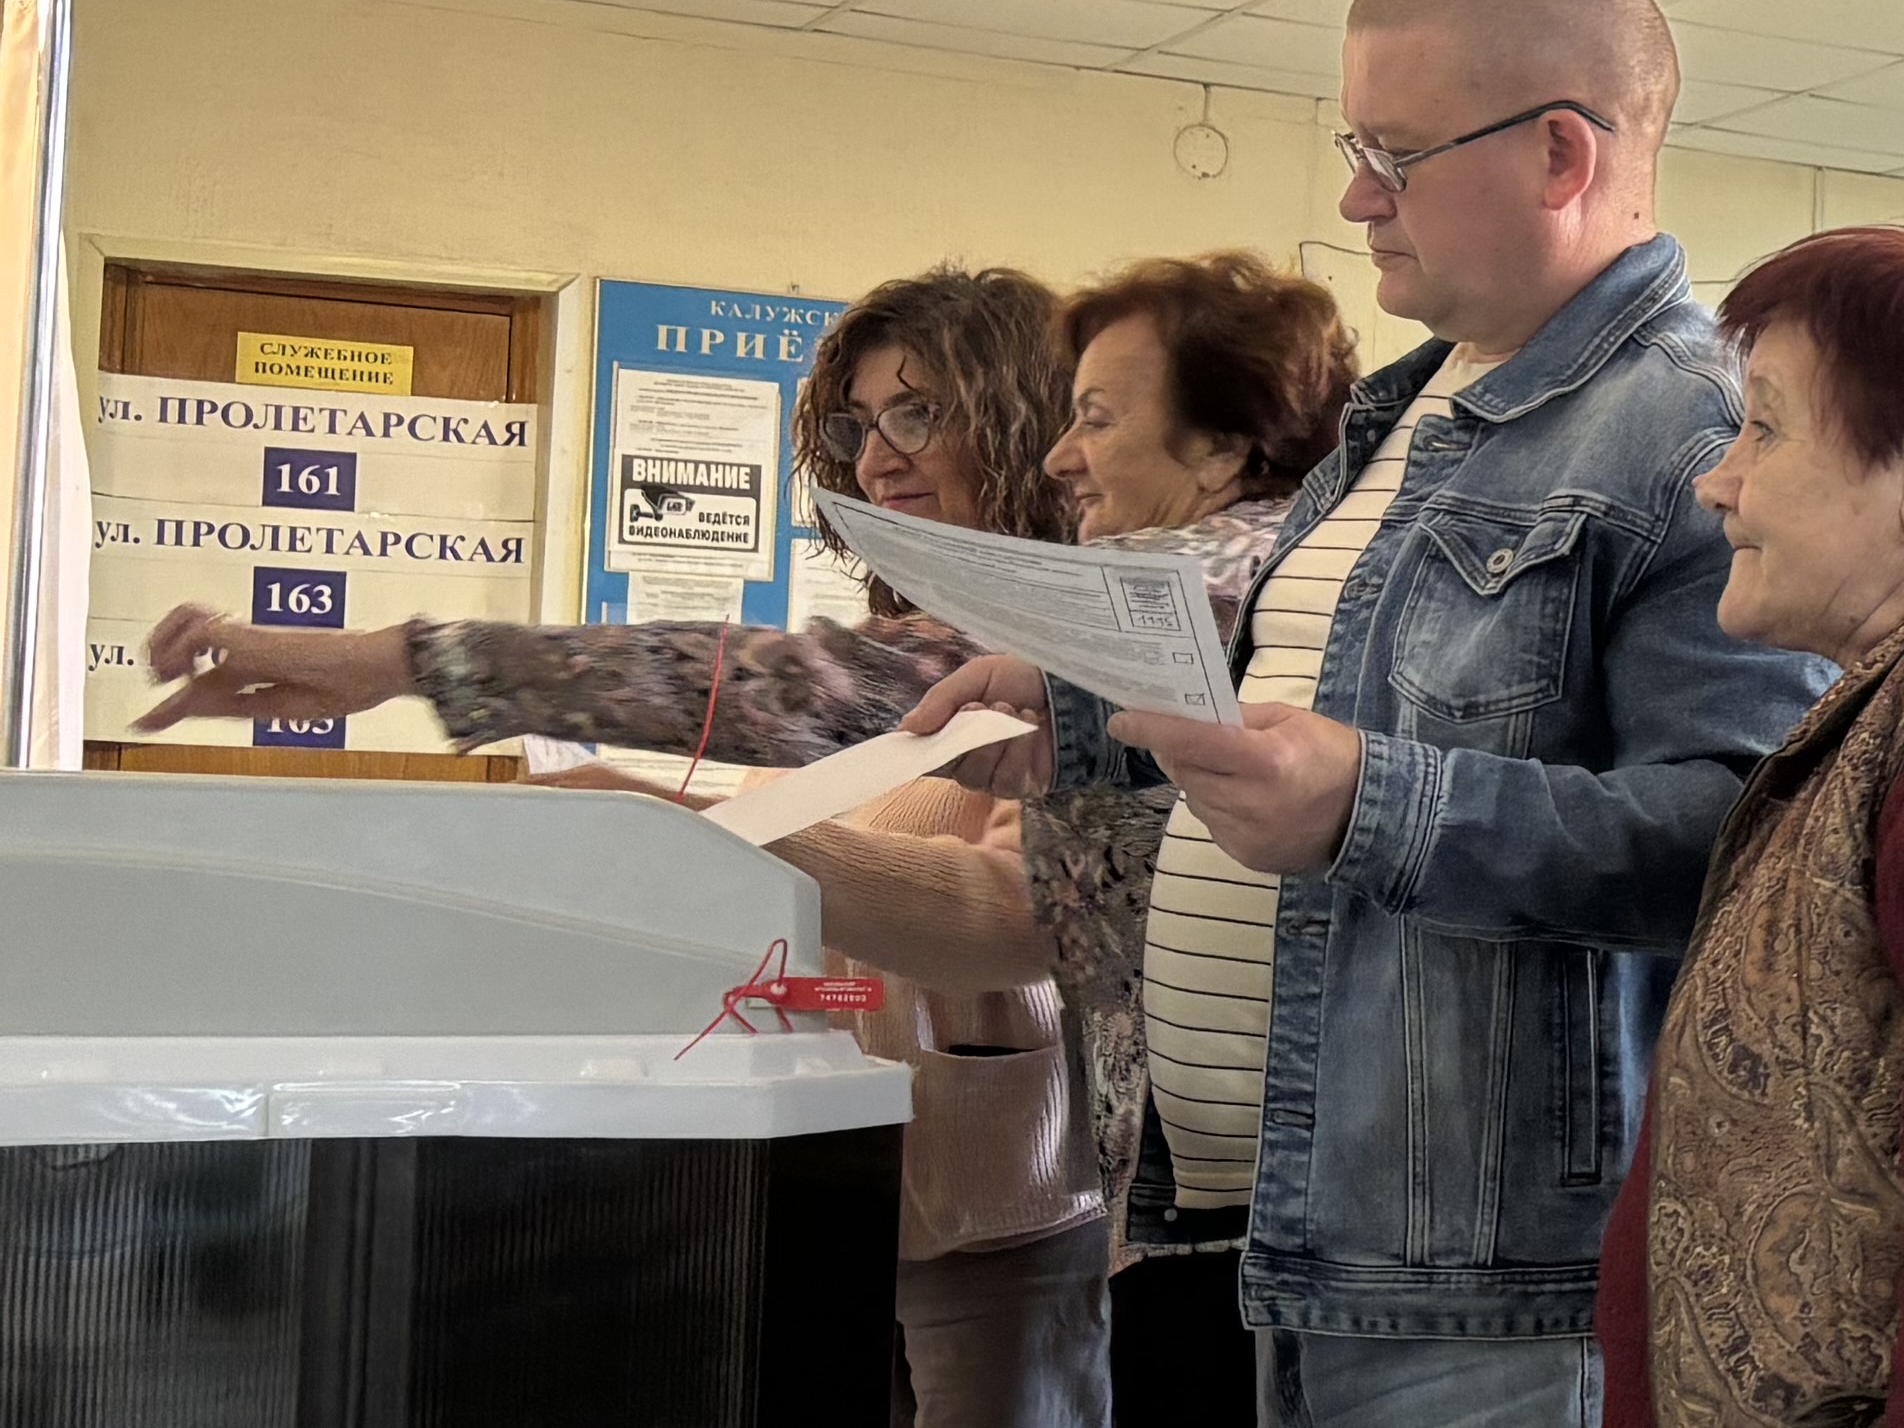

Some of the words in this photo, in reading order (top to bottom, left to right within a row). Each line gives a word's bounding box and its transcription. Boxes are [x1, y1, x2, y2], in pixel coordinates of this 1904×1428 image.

[711, 300, 838, 327] КАЛУЖСК
[260, 342, 393, 365] СЛУЖЕБНОЕ
[656, 324, 804, 362] ПРИЁ
[254, 361, 394, 385] ПОМЕЩЕНИЕ
[98, 395, 143, 424] ул.
[158, 396, 528, 447] ПРОЛЕТАРСКАЯ
[275, 463, 341, 496] 161
[632, 458, 751, 490] ВНИМАНИЕ
[698, 510, 750, 526] ВЕДЁТСЯ
[95, 520, 141, 549] ул.
[154, 518, 525, 564] ПРОЛЕТАРСКАЯ
[628, 524, 749, 544] ВИДЕОНАБЛЮДЕНИЕ
[266, 583, 333, 614] 163
[88, 643, 134, 671] ул.
